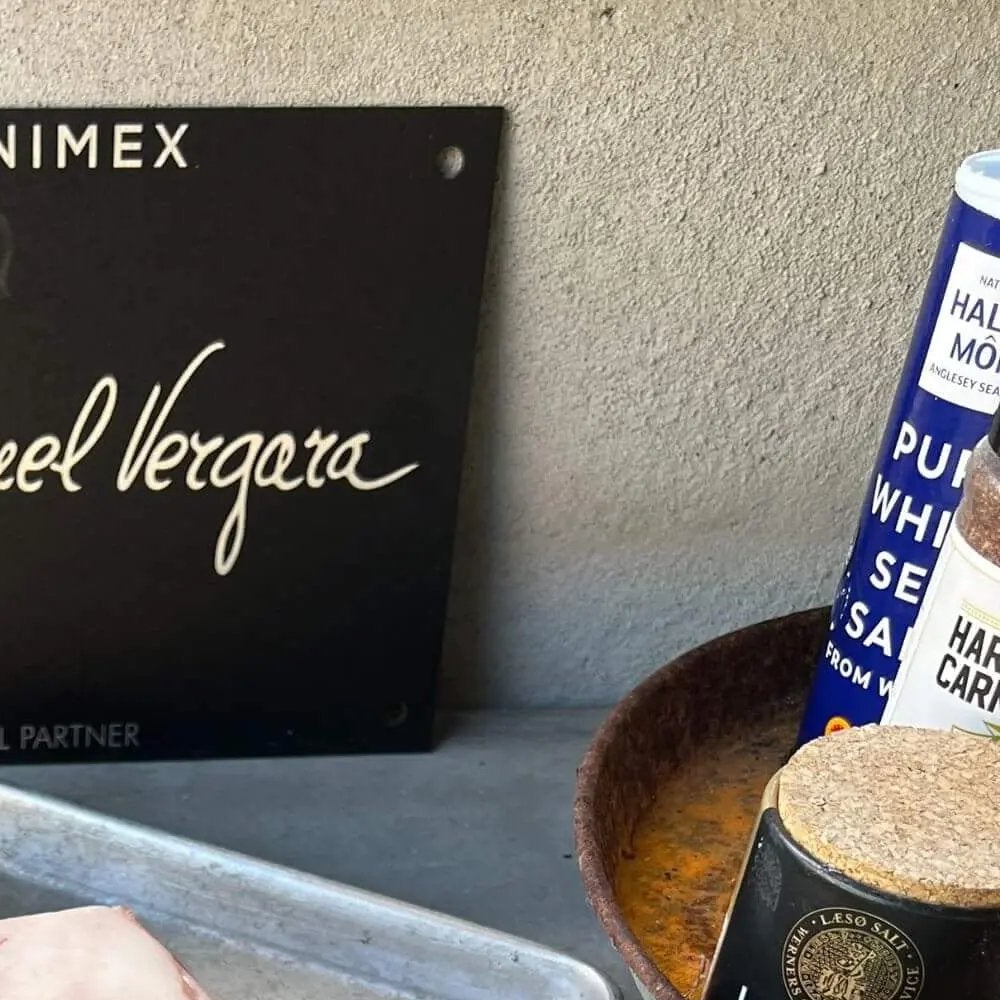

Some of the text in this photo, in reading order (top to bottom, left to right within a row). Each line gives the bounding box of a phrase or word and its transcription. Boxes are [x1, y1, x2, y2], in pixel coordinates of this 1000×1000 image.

[950, 332, 1000, 373] MÔ
[929, 362, 977, 390] ANGLESEY
[116, 341, 419, 575] Vergara
[845, 601, 913, 661] SA
[825, 640, 871, 690] FROM
[19, 721, 140, 751] PARTNER
[820, 913, 909, 951] LÆSØ SALT
[785, 926, 809, 997] WERNERS
